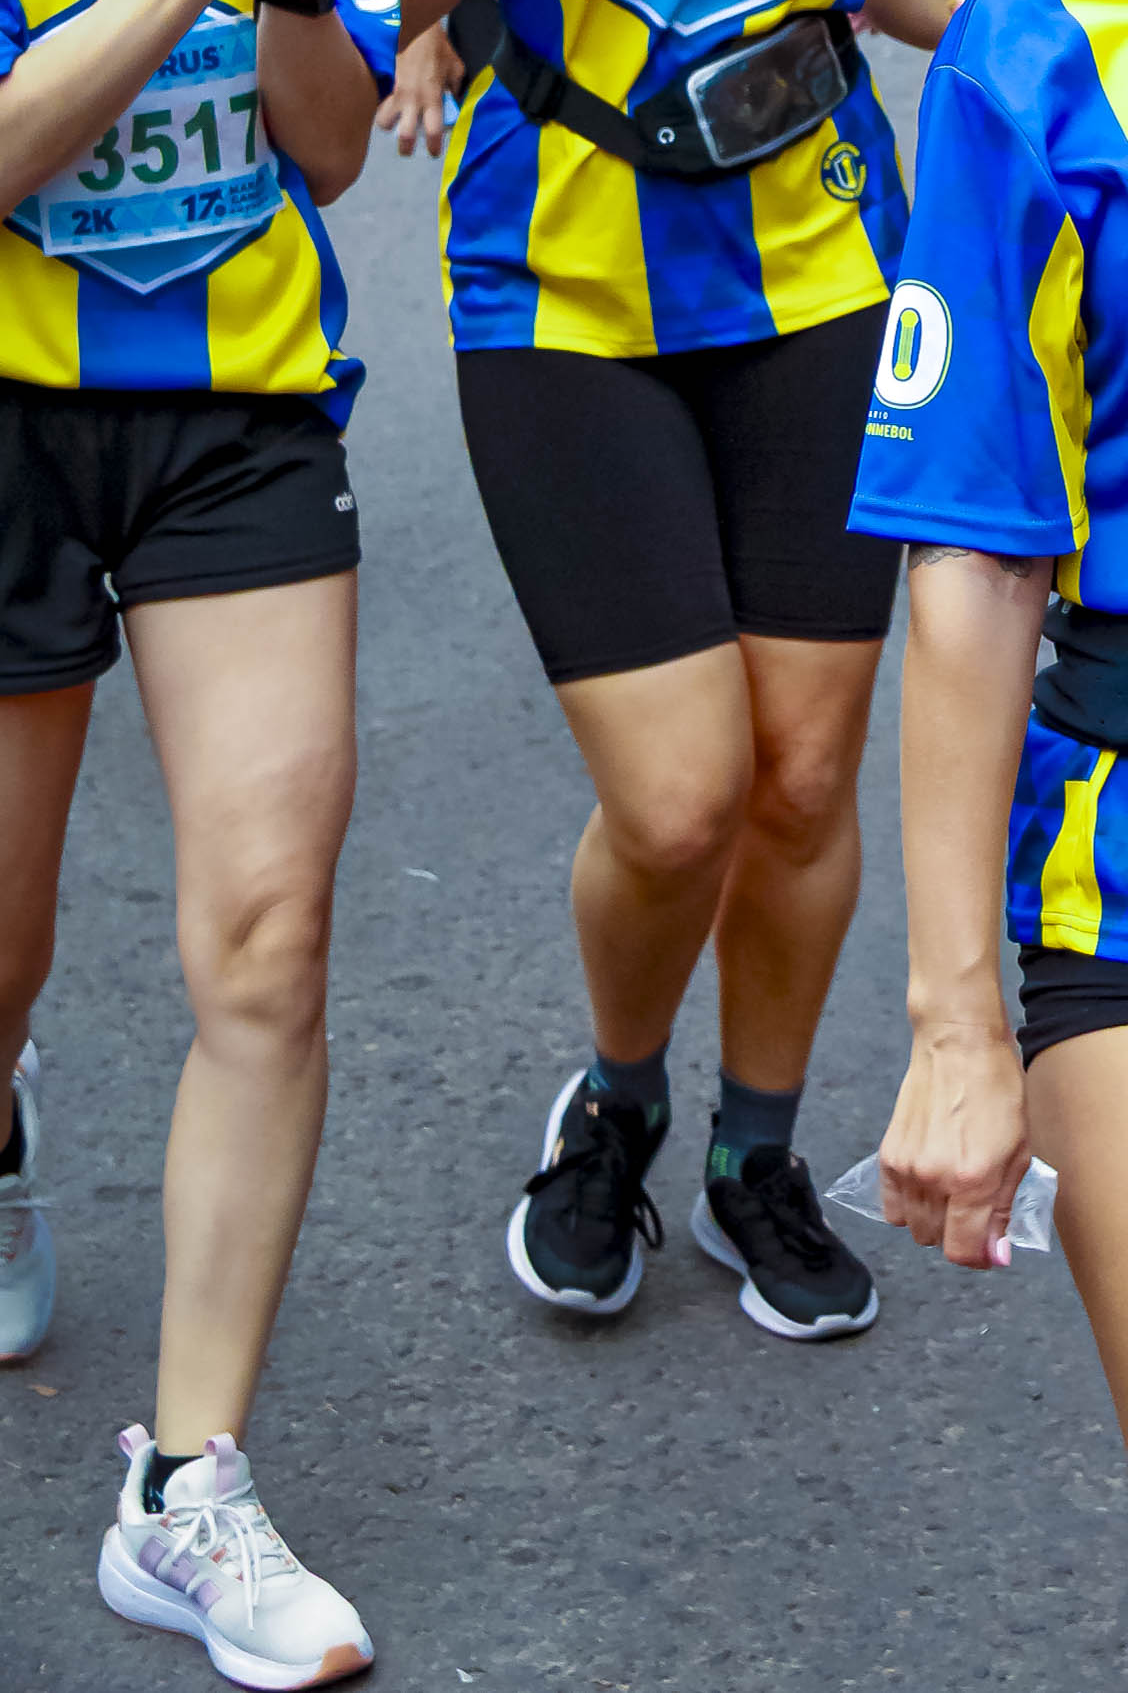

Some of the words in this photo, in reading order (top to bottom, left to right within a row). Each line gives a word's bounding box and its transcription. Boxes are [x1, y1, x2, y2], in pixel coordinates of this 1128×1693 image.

[158, 45, 222, 78] RUS
[77, 89, 259, 193] 3517
[71, 208, 118, 236] 2K
